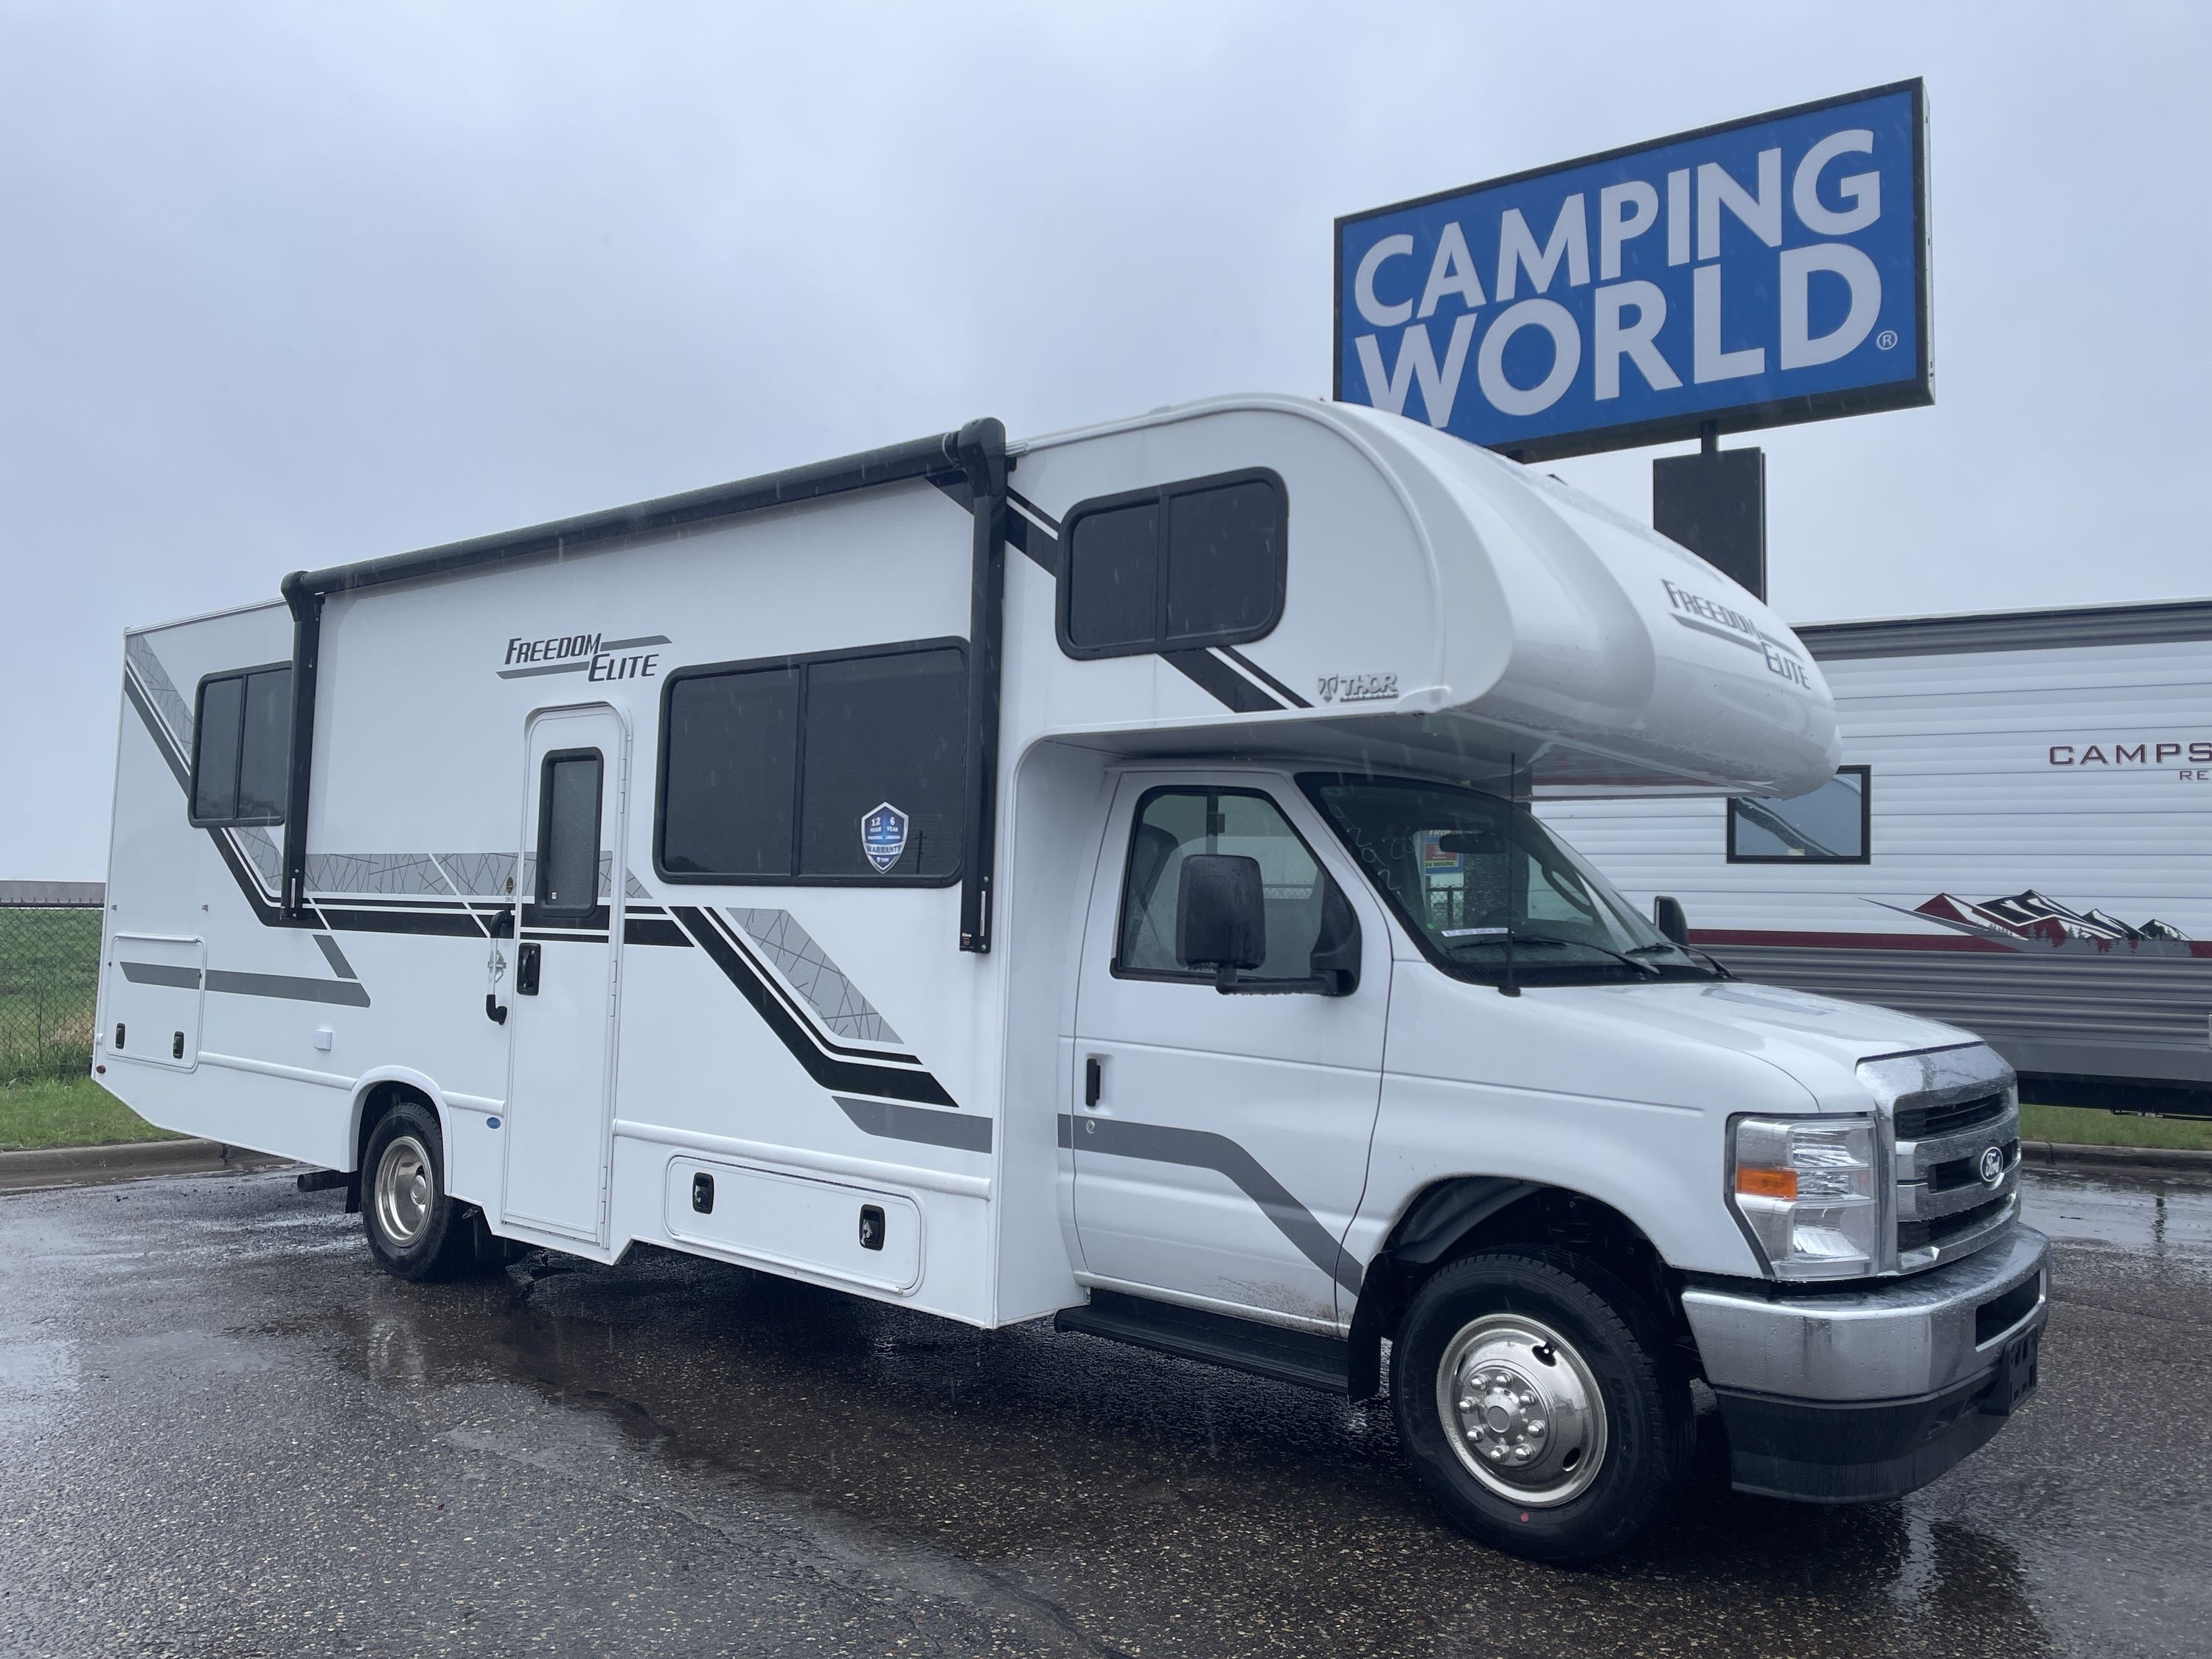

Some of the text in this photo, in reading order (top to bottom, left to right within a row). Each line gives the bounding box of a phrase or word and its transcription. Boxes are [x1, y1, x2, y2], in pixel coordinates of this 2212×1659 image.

[1354, 128, 1881, 327] CAMPING
[1354, 243, 1882, 429] WORLD
[1660, 578, 1763, 641] FREEDOM
[504, 633, 602, 665] FREEDOM
[588, 653, 660, 683] ELITE
[1761, 640, 1812, 690] ELITE
[1339, 672, 1398, 697] THOR
[2048, 742, 2212, 766] CAMPS
[871, 816, 881, 827] 12
[889, 816, 896, 826] 6
[866, 844, 902, 854] WARRANTY
